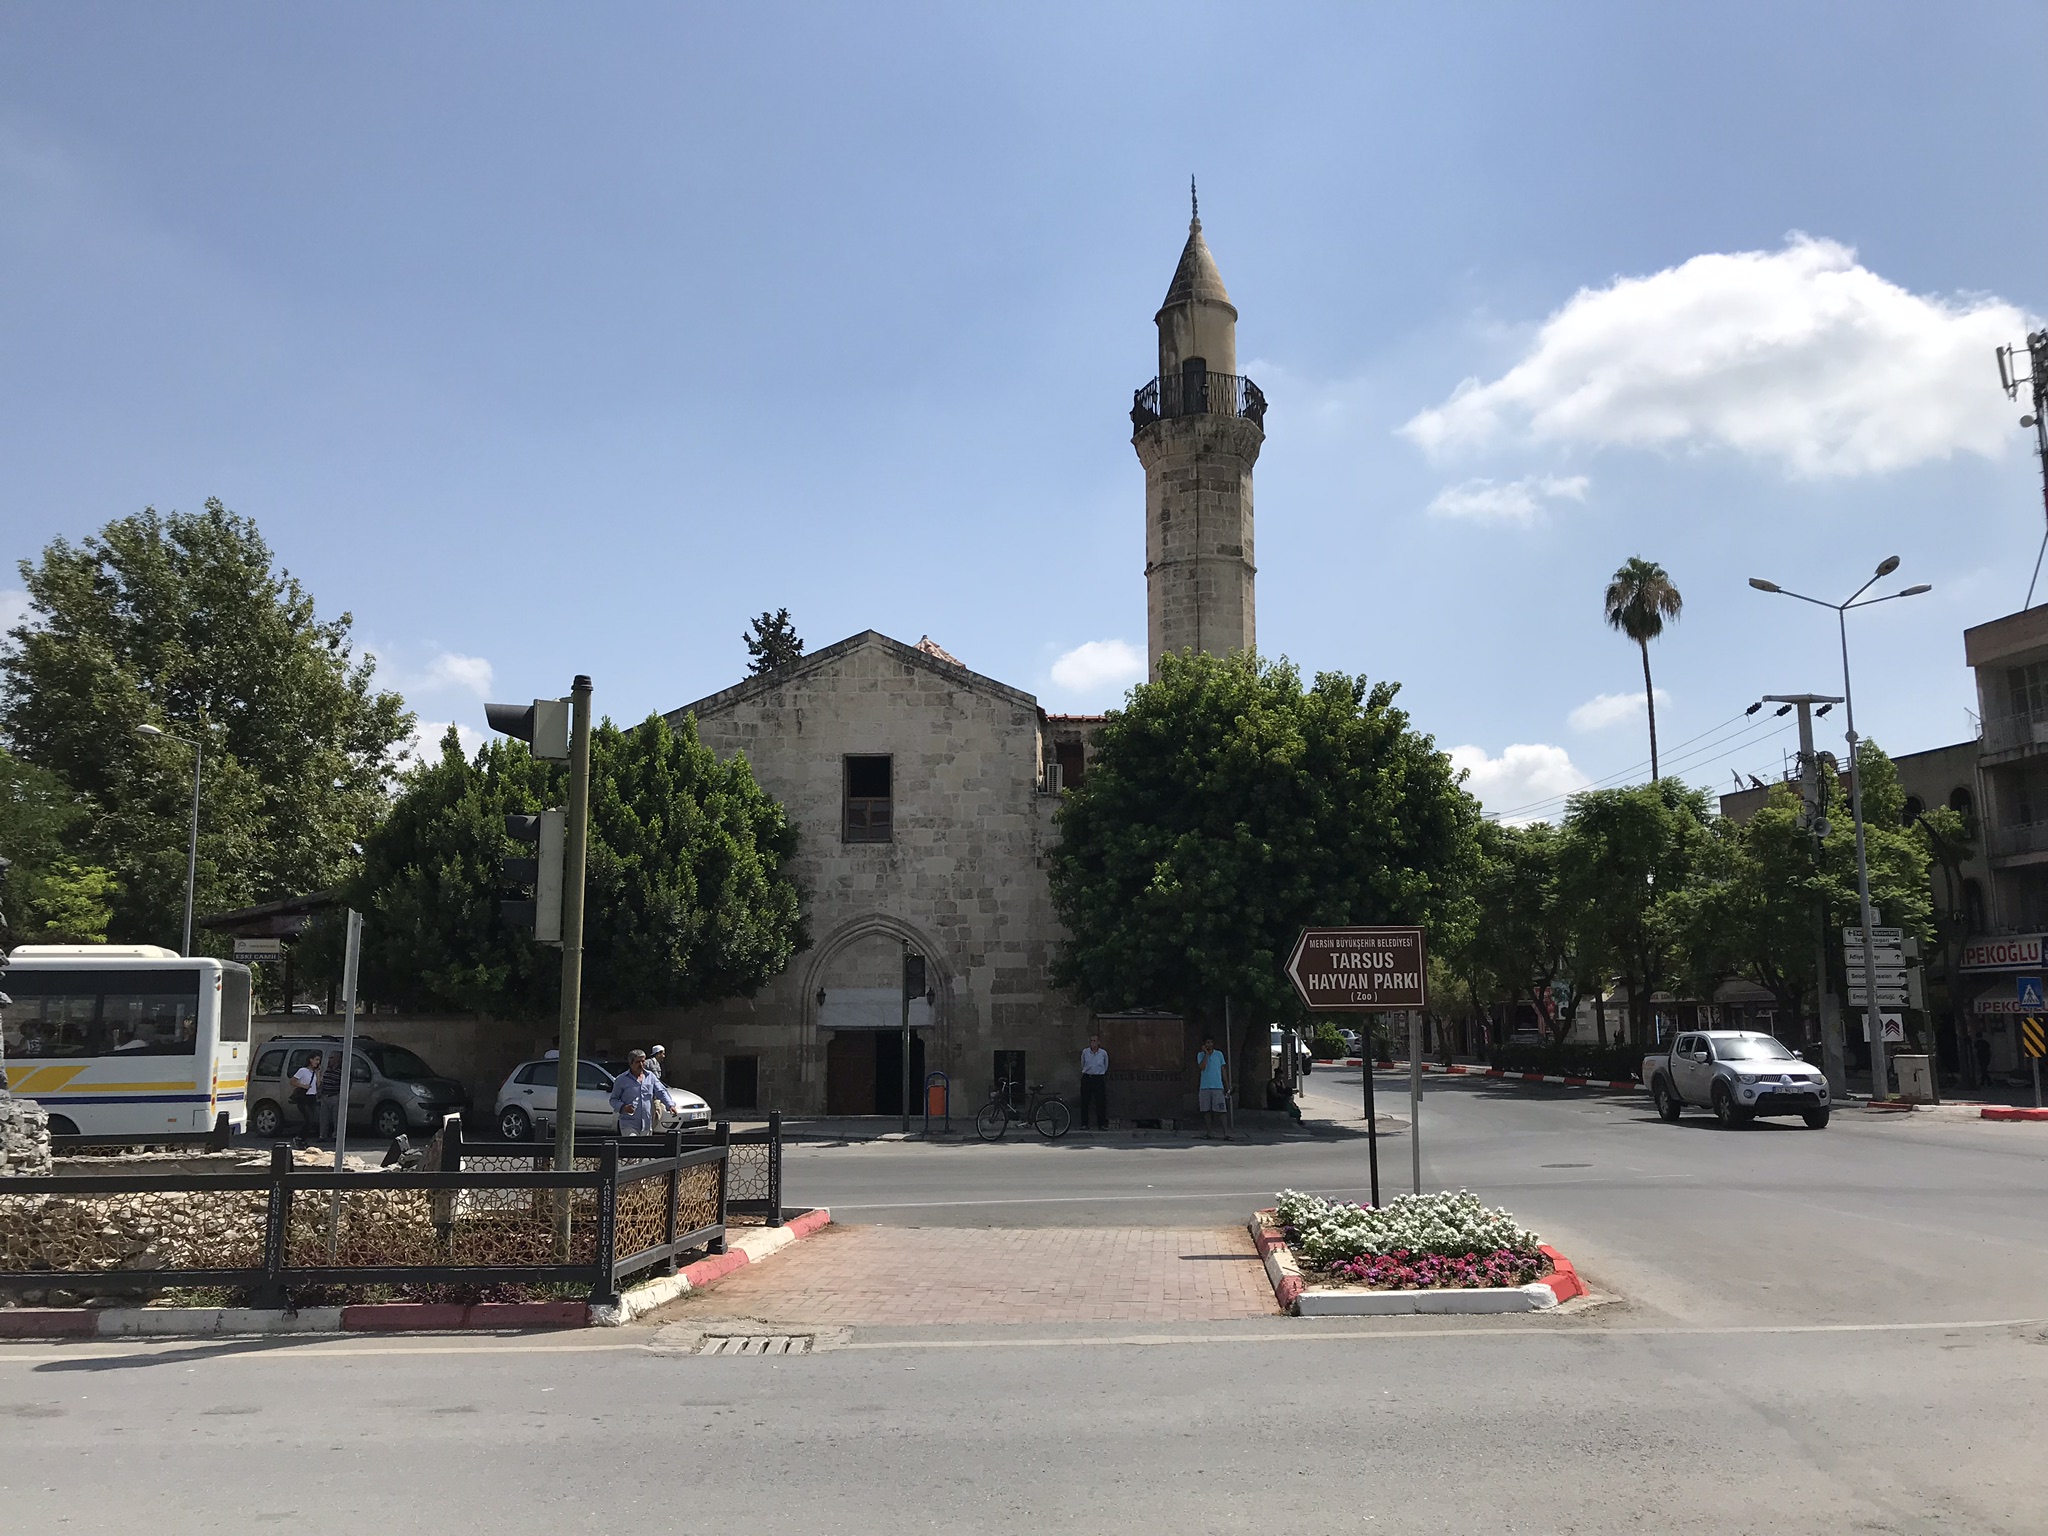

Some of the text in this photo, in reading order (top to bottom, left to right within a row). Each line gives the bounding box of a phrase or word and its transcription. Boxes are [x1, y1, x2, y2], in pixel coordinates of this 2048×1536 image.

[1309, 936, 1413, 950] MERSİN BÜYÜKŞEHİR BELEDİYESİ
[1330, 952, 1395, 969] TARSUS
[1308, 972, 1419, 990] HAYVAN PARKI
